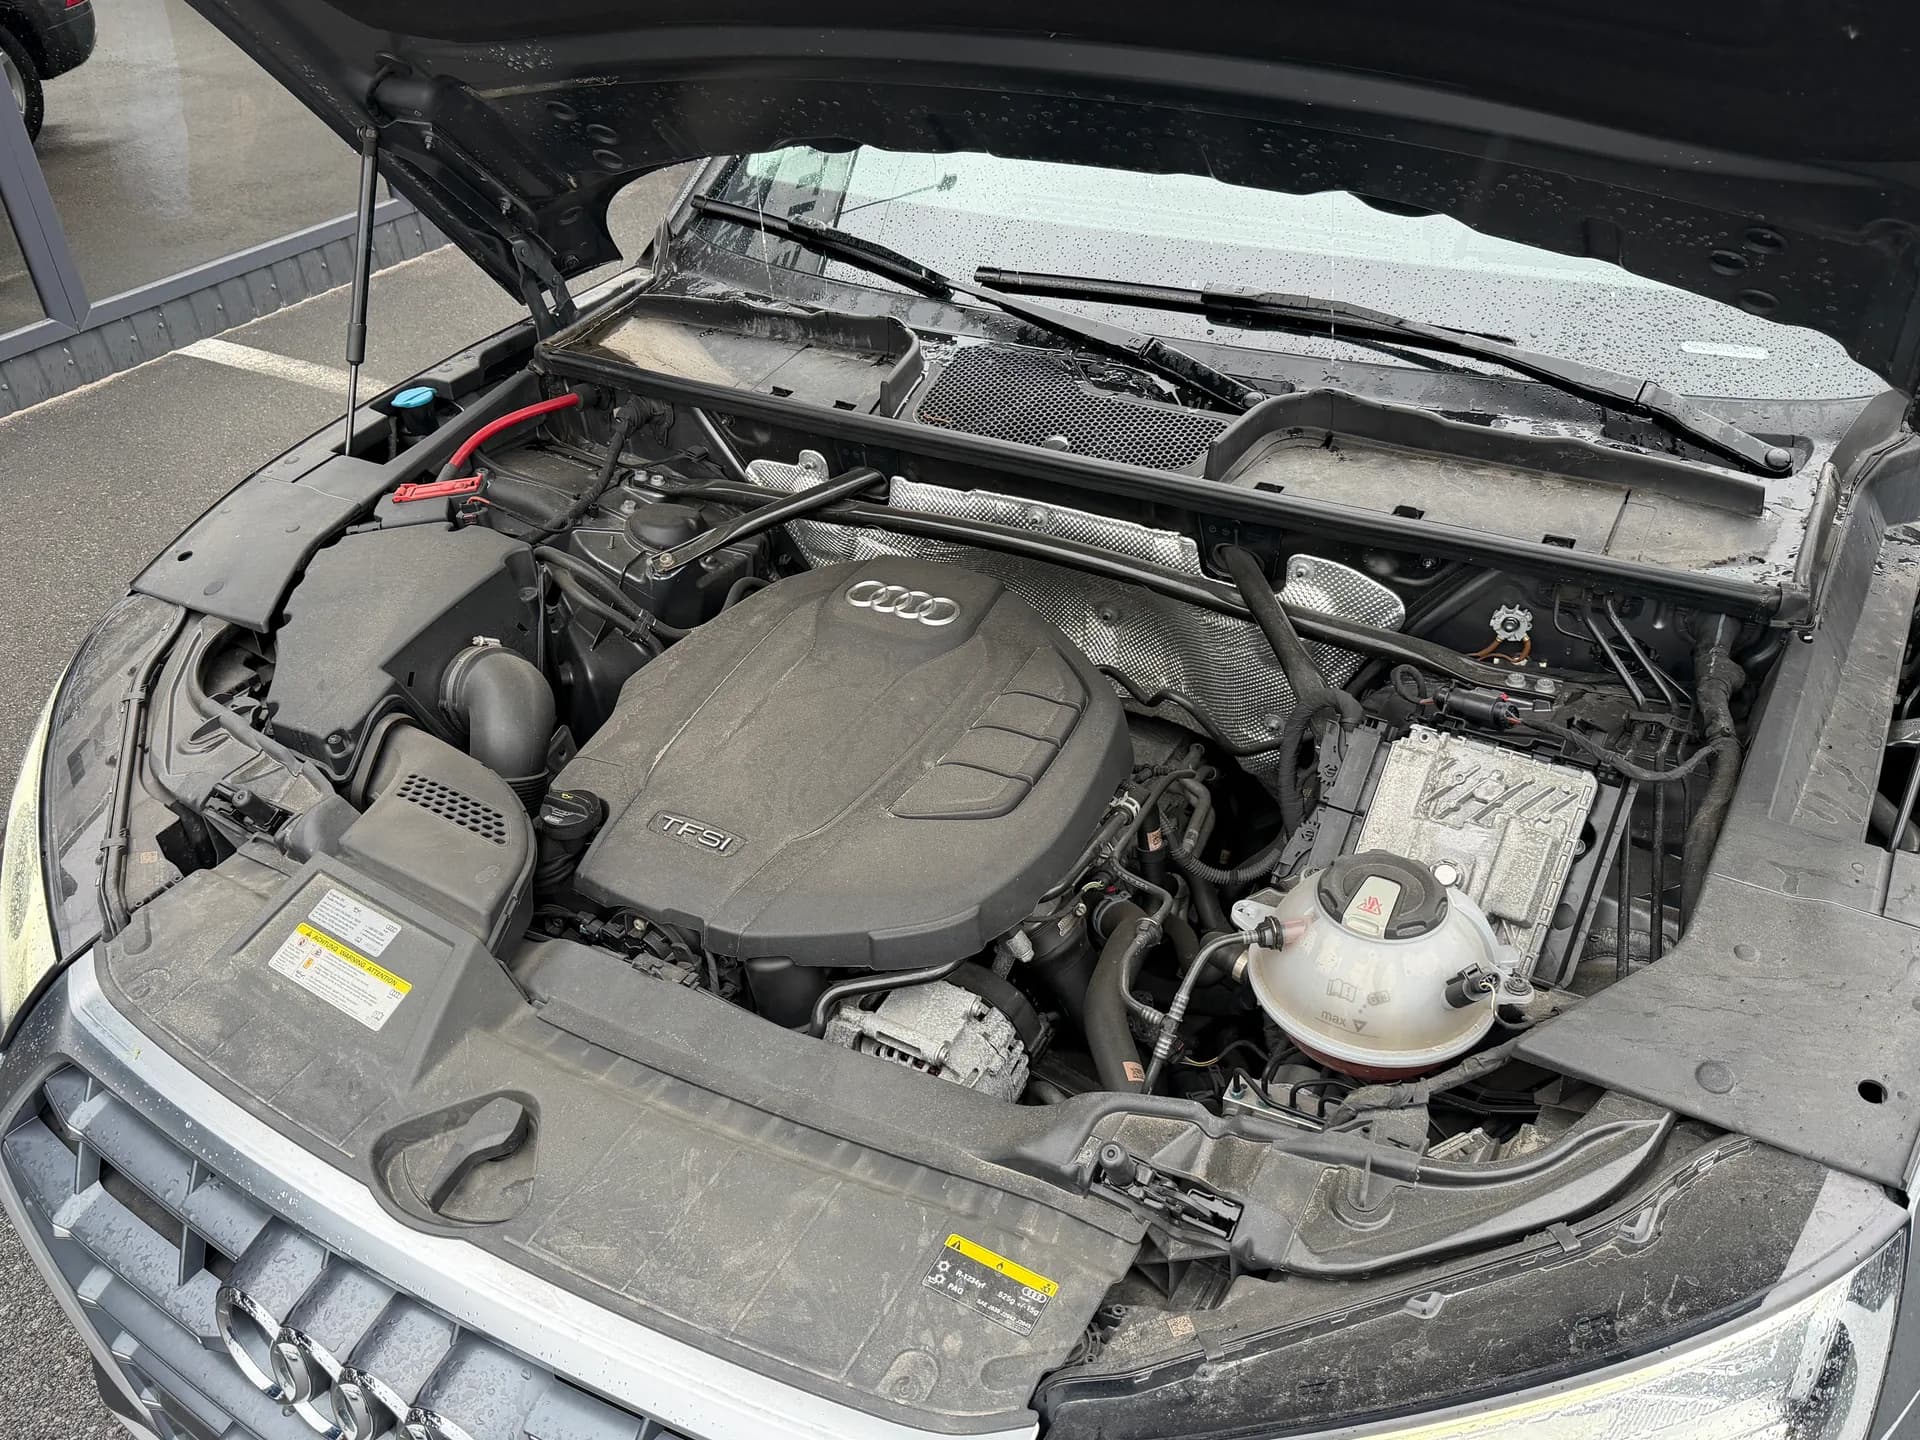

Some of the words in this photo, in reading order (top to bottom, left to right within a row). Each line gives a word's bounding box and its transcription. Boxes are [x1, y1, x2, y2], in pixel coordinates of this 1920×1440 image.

[663, 815, 733, 850] TFSI
[313, 934, 339, 953] ACHTUNG
[340, 949, 366, 968] WARNING
[367, 966, 398, 986] ATTENTION
[1320, 1010, 1346, 1027] max
[947, 1282, 964, 1295] PAG
[955, 1270, 986, 1289] R-1234yf
[997, 1291, 1015, 1305] 525g
[1017, 1301, 1039, 1316] +/-15g
